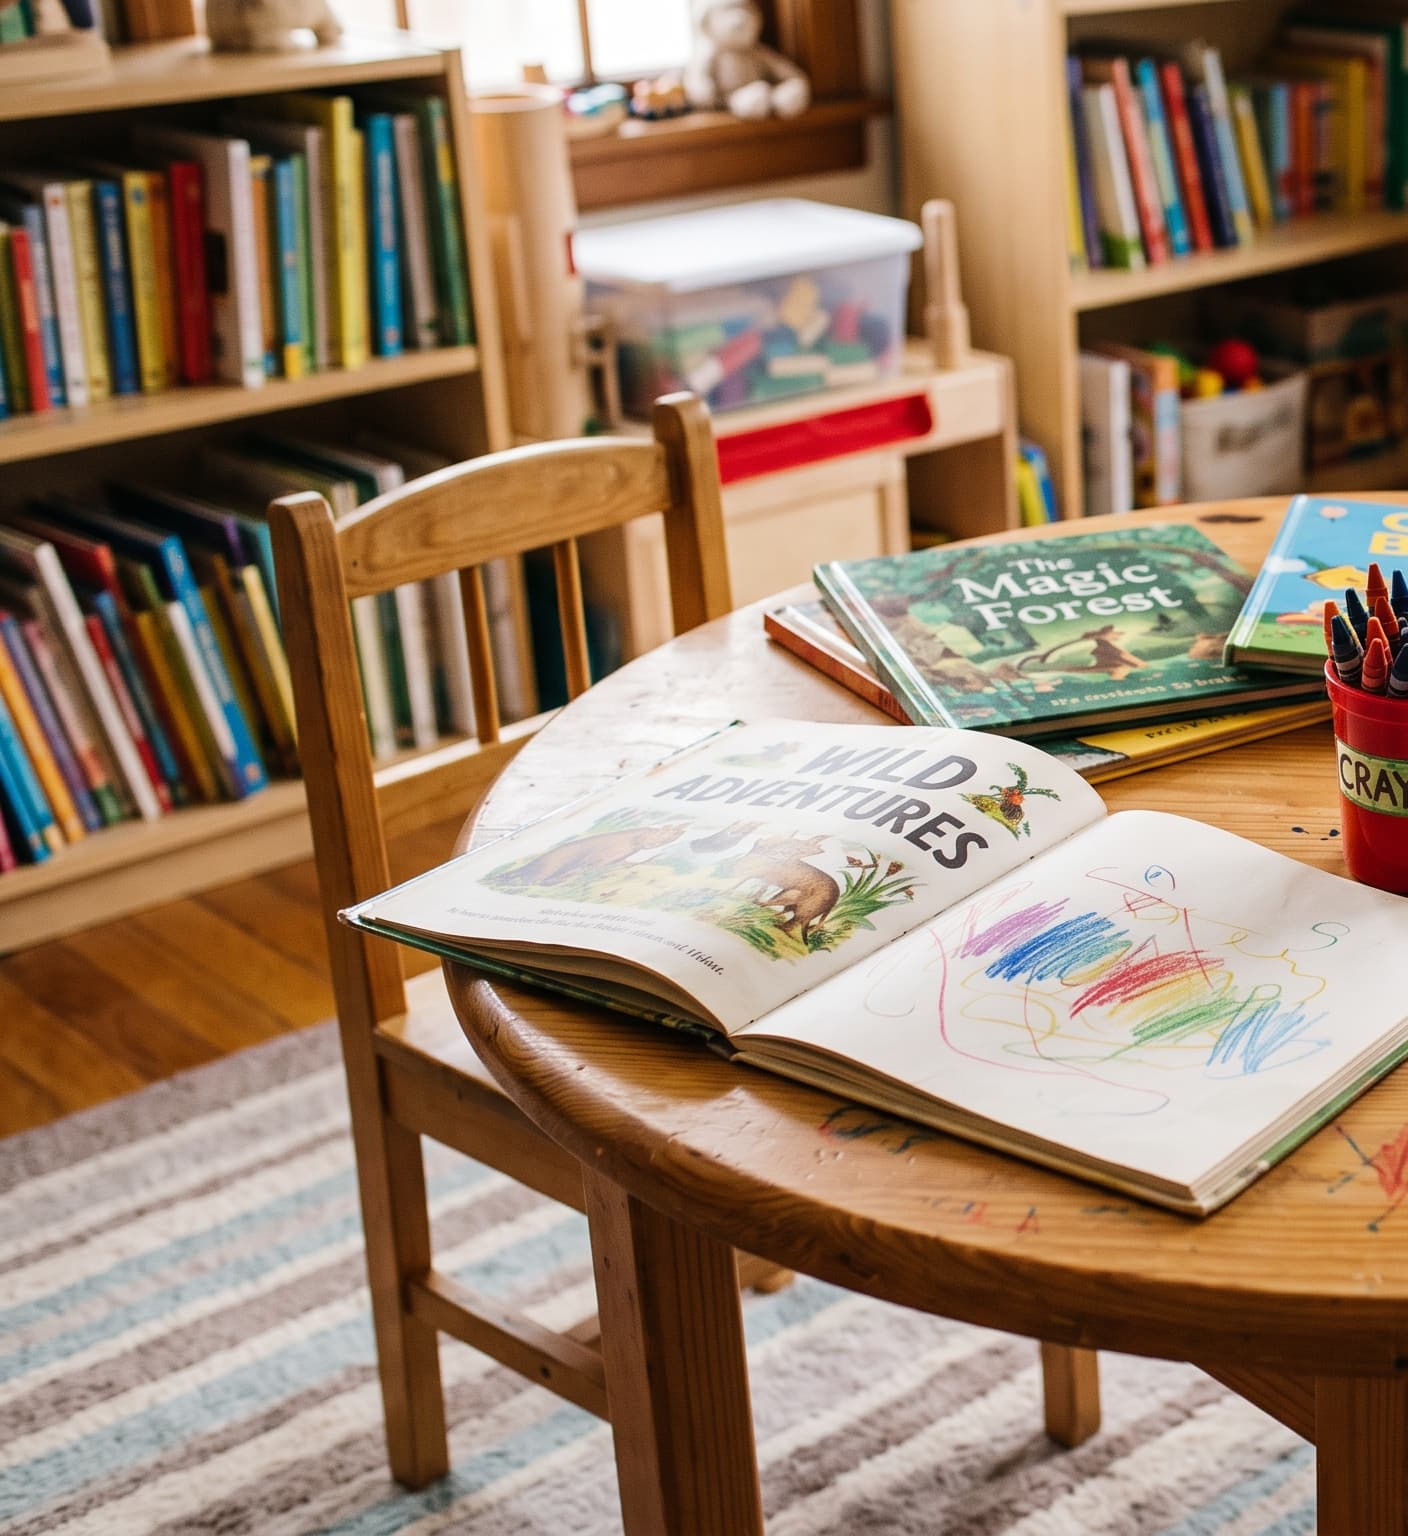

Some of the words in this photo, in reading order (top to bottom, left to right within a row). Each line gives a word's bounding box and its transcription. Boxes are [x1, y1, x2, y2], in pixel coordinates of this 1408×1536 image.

[952, 562, 1158, 603] Magic
[1007, 558, 1075, 575] The
[972, 586, 1183, 631] Forest
[796, 745, 979, 790] WILD
[652, 774, 989, 870] ADVENTURES
